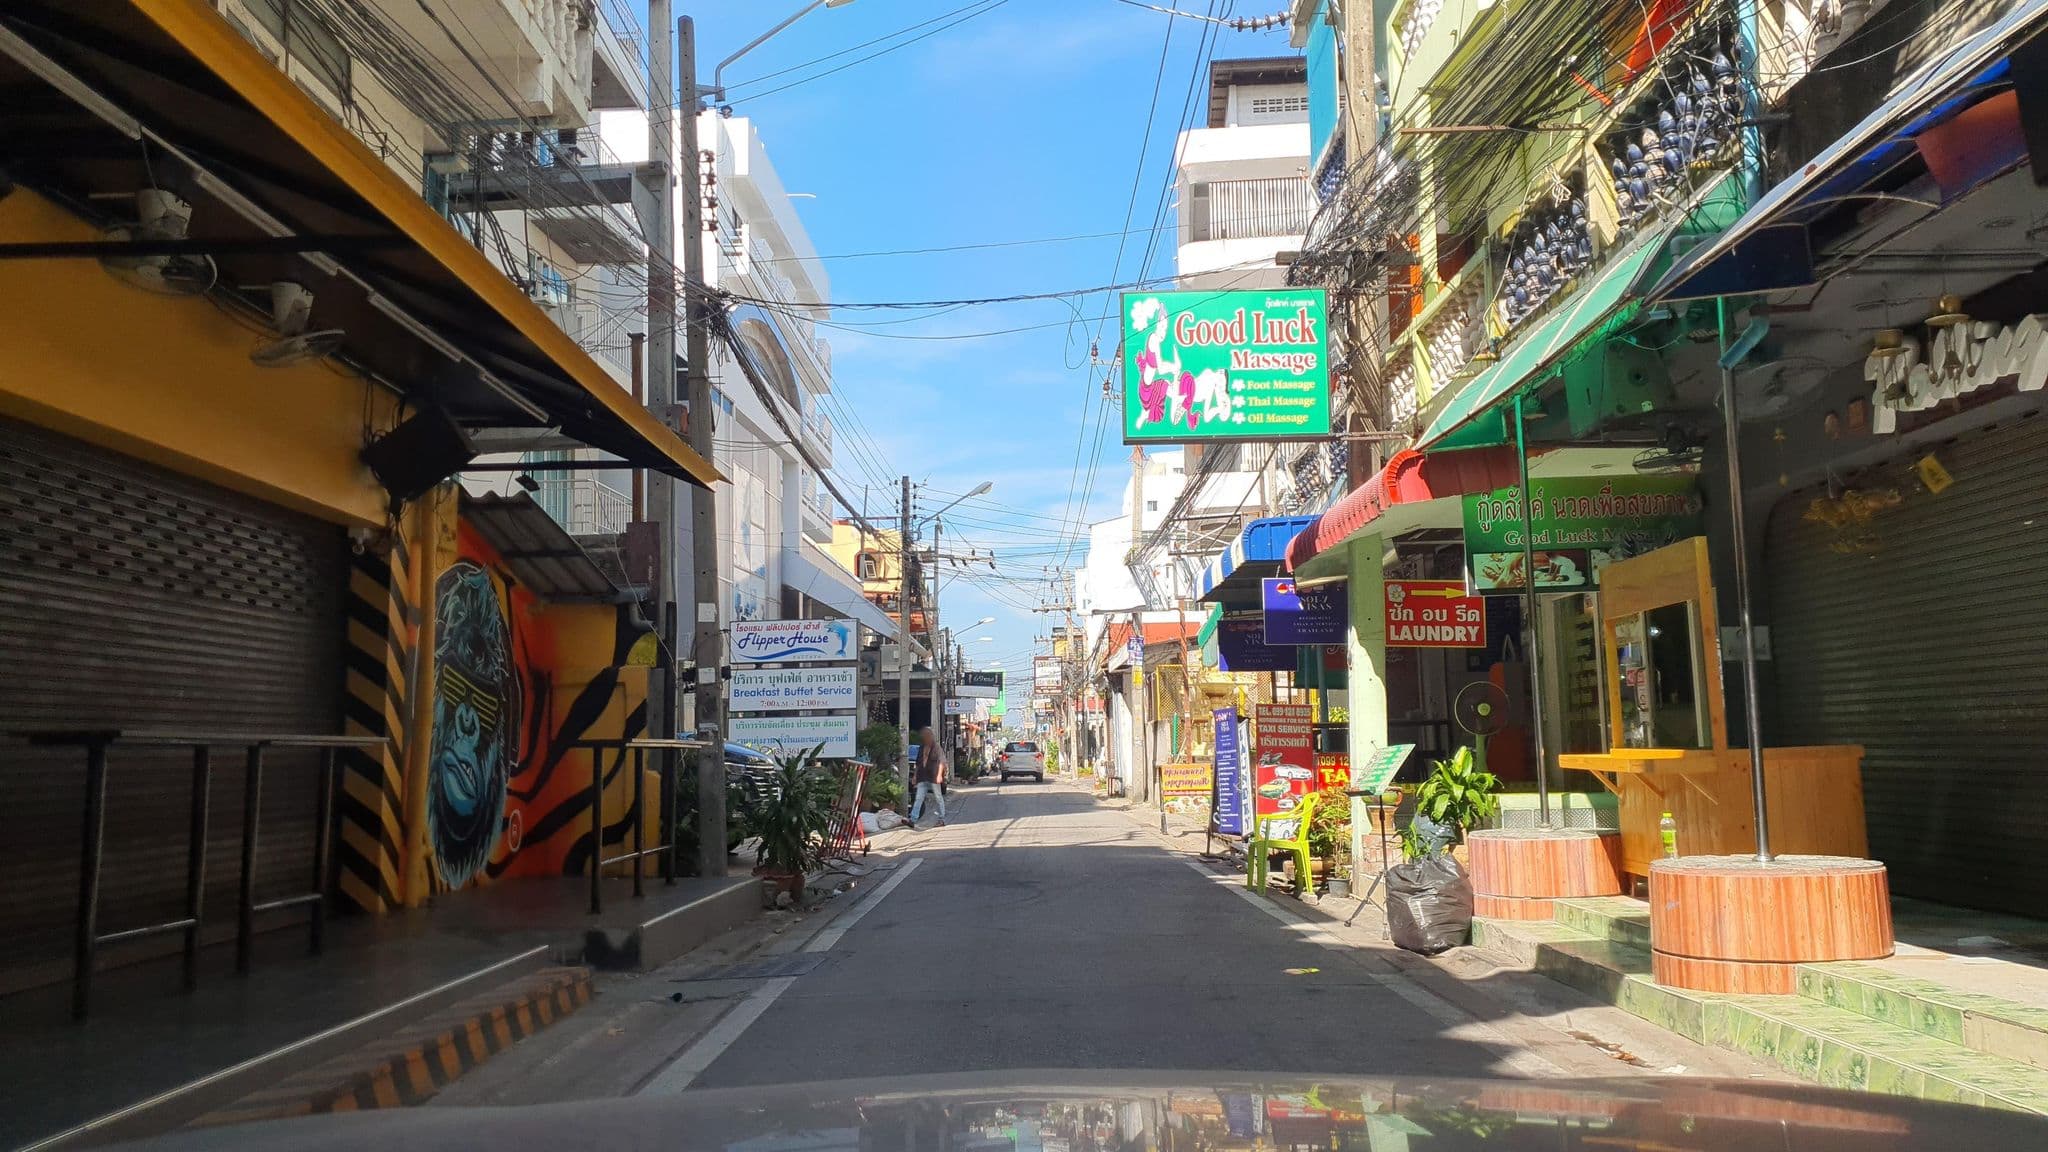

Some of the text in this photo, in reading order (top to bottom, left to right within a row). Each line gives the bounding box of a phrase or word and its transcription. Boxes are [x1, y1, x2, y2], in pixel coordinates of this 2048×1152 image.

[1175, 307, 1317, 346] Good Luck
[1230, 350, 1316, 375] Massage
[1247, 380, 1315, 391] Foot Massage
[1247, 396, 1315, 408] Thai Massage
[1247, 413, 1309, 425] Oil Massage
[1504, 529, 1551, 545] Good
[1557, 529, 1596, 544] Luck
[1390, 603, 1414, 621] ซัก
[1422, 608, 1448, 621] อบ
[736, 623, 763, 632] โรงแรม
[1390, 625, 1480, 641] LAUNDRY
[738, 631, 829, 650] Flipper House
[734, 672, 764, 684] บริการ
[807, 671, 853, 683] อาหารเช้า
[733, 686, 852, 697] Breakfast Buffet Service
[1258, 725, 1311, 734] TAXI SERVICE
[1321, 756, 1336, 766] 099
